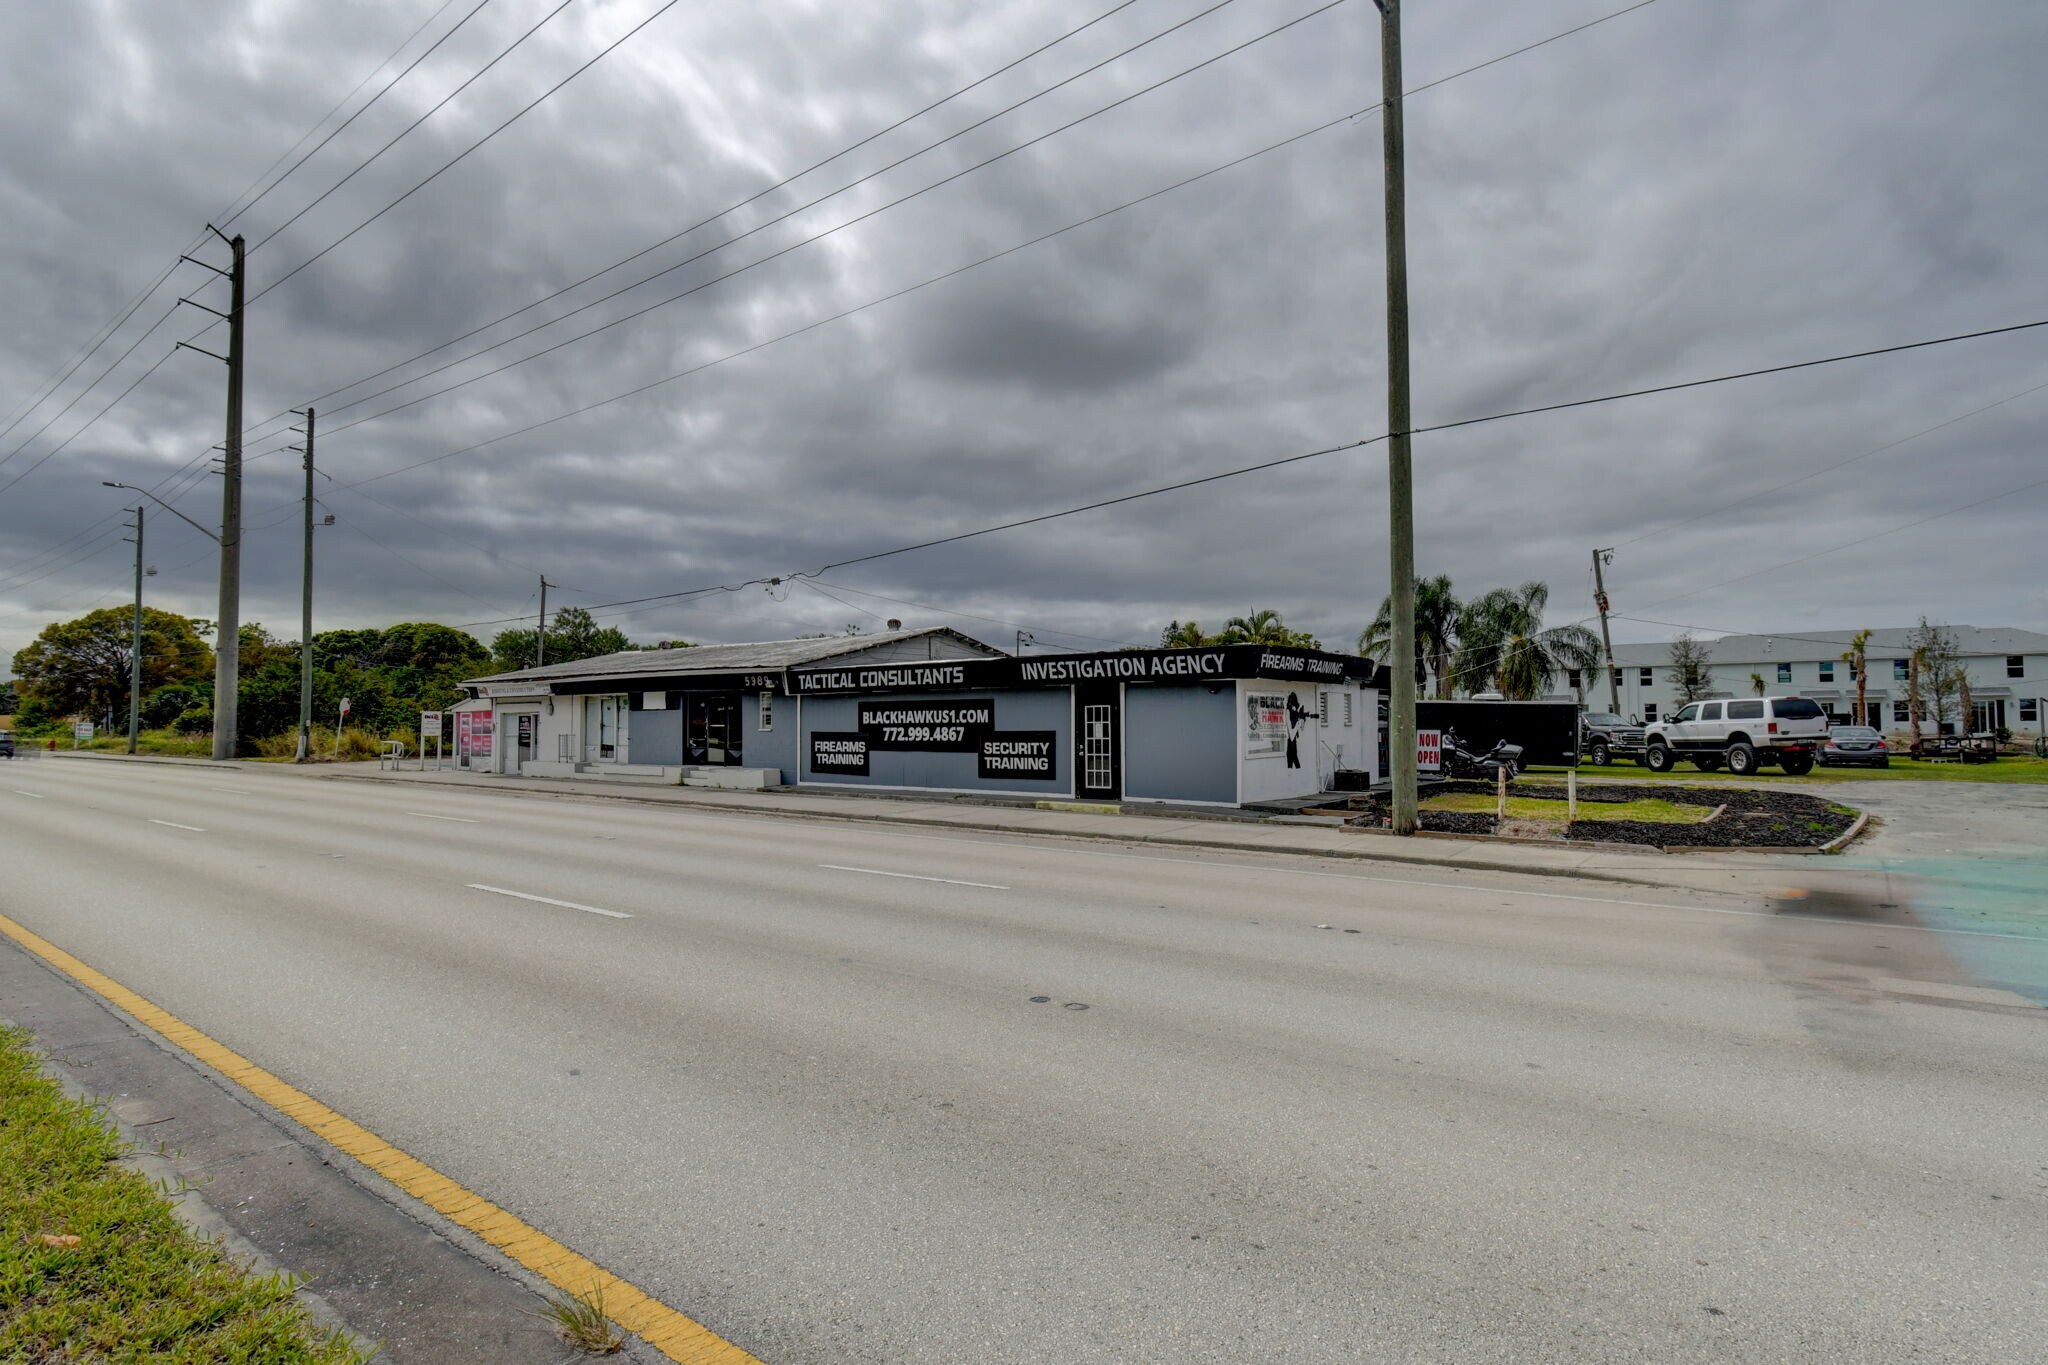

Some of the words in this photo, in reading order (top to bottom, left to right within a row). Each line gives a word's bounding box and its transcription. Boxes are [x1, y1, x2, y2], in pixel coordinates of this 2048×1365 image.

[1021, 657, 1146, 681] INVESTIGATION
[1150, 653, 1226, 676] AGENCY
[1260, 654, 1304, 671] FIREARMS
[1307, 659, 1343, 675] TRAINING
[798, 672, 856, 690] TACTICAL
[859, 666, 964, 688] CONSULTANTS
[862, 709, 989, 725] BLACKHAWKUS1.COM
[882, 726, 965, 742] 772.999.4867
[1418, 733, 1439, 747] NOW
[814, 740, 866, 753] FIREARMS
[983, 741, 1050, 756] SECURITY
[815, 752, 865, 766] TRAINING
[984, 756, 1049, 771] TRAINING
[1417, 750, 1440, 764] OPEN
